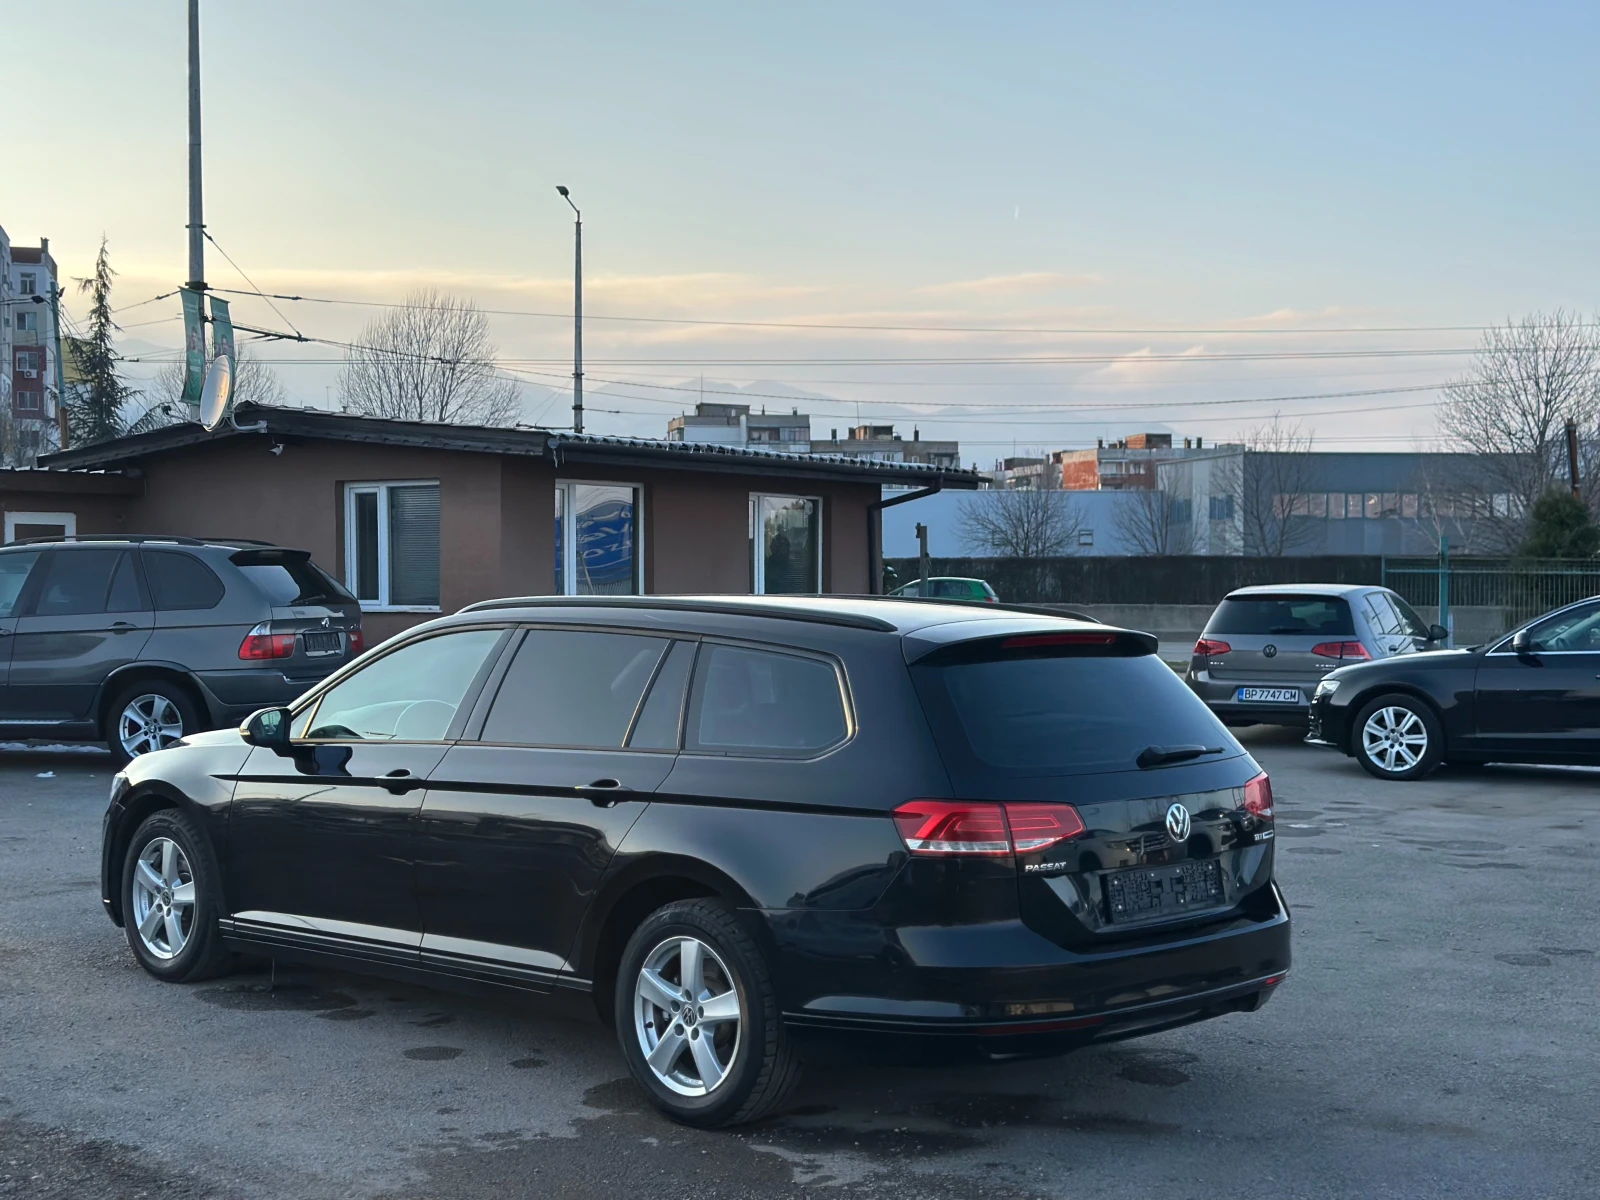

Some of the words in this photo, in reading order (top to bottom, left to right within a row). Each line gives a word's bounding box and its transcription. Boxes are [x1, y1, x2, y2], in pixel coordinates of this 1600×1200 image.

[1244, 689, 1258, 699] BP
[1259, 689, 1282, 700] 7747
[1283, 690, 1297, 700] CM
[1025, 861, 1067, 872] PASSAT
